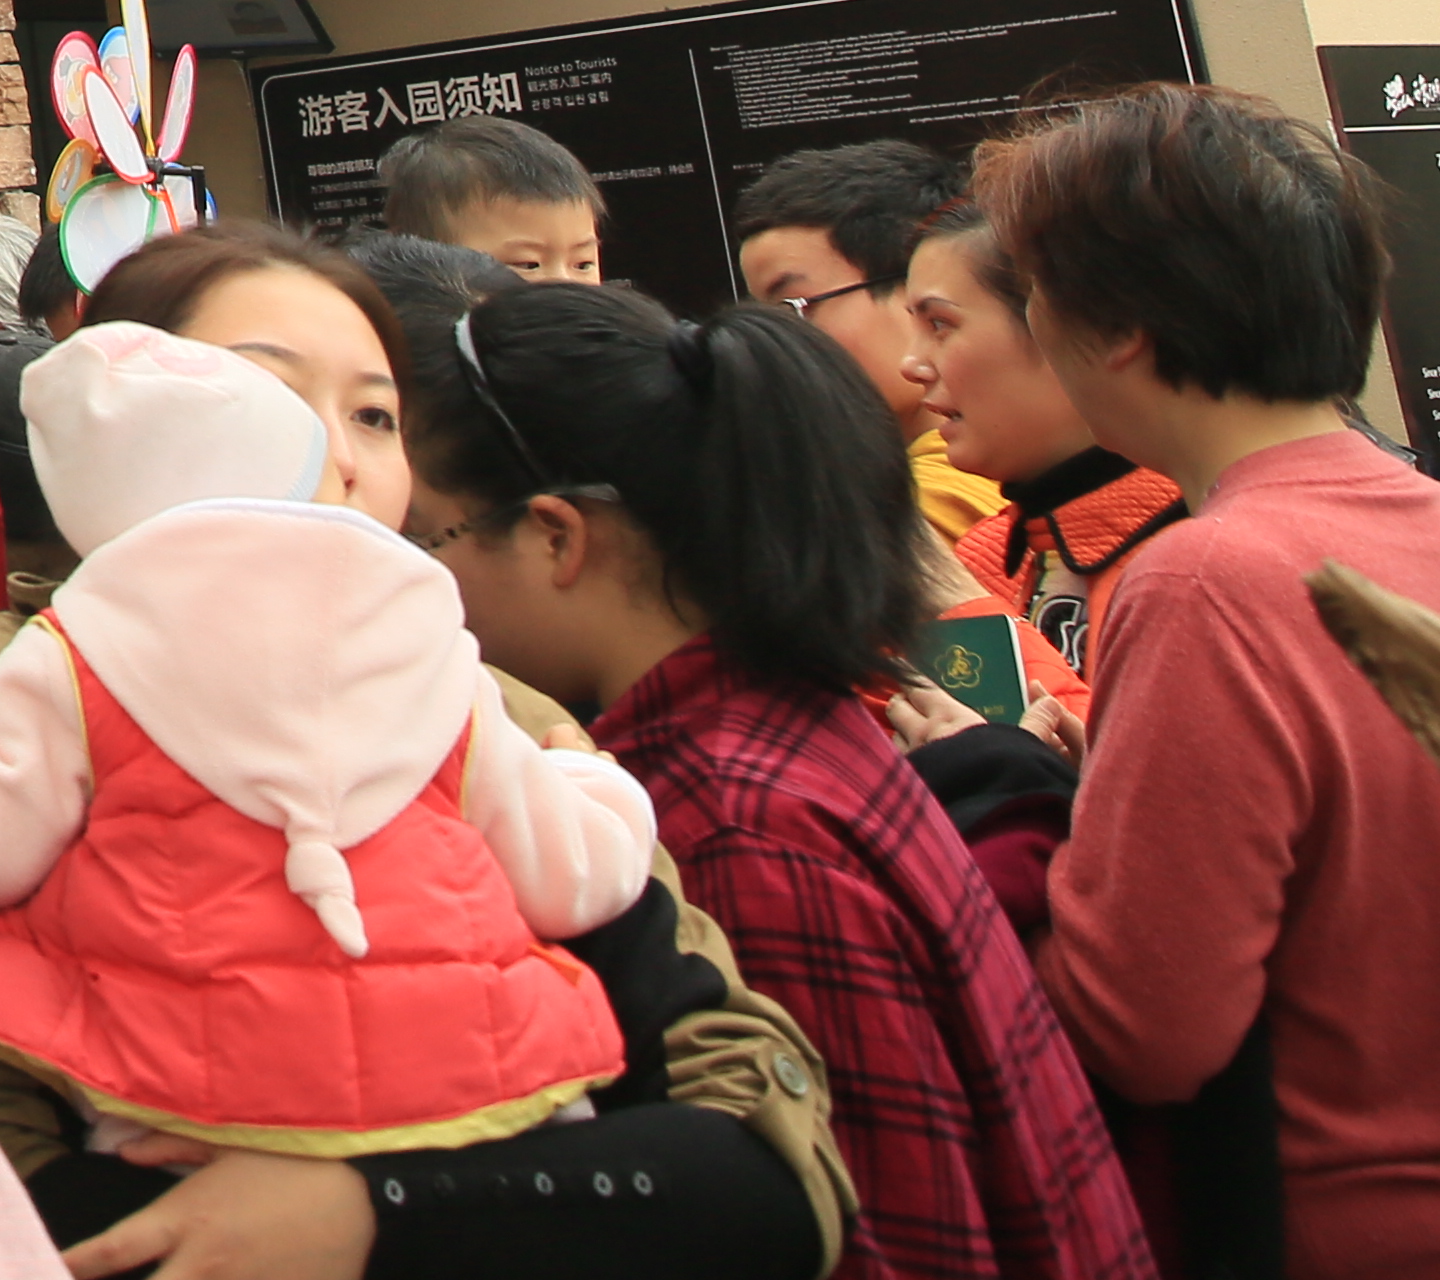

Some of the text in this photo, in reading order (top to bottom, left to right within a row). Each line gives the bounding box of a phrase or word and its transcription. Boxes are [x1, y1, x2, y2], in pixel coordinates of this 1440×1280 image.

[525, 57, 618, 76] Notice to Tourists
[297, 71, 524, 139] 游客入园须知
